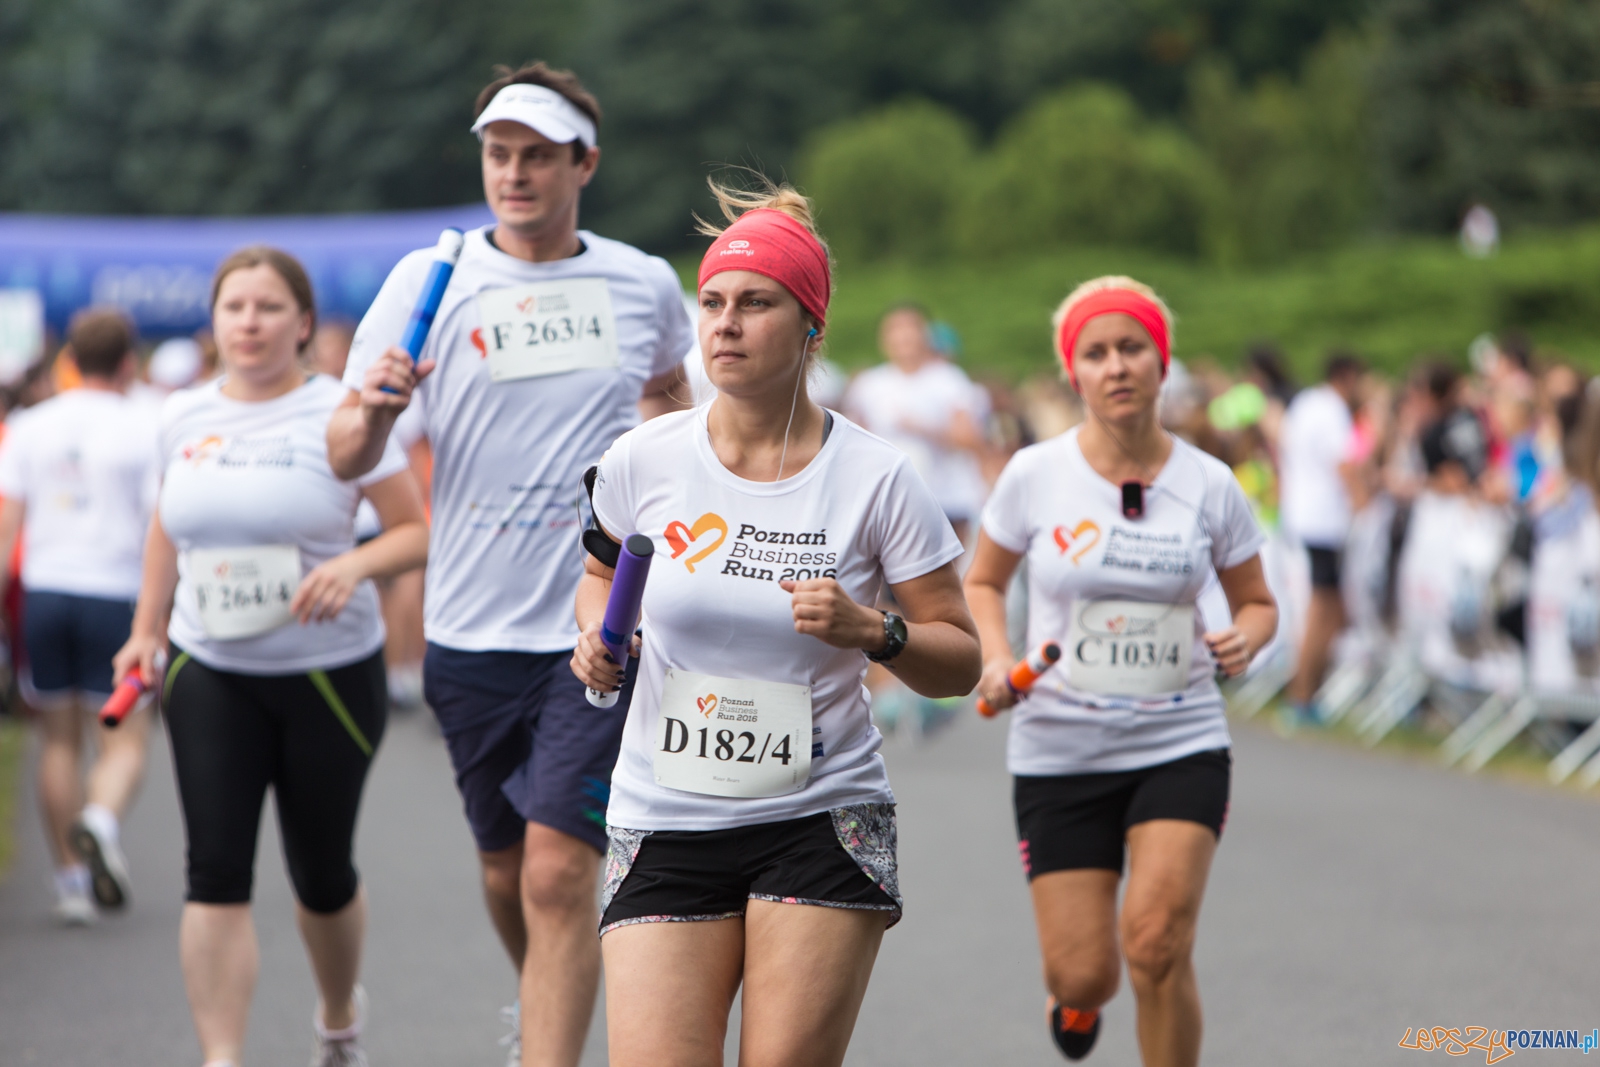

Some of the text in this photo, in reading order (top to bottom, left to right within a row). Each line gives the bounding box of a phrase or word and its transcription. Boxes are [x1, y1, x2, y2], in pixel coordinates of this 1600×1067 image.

[492, 315, 602, 350] F 263/4
[736, 523, 828, 546] Poznań
[728, 541, 838, 566] Business
[720, 559, 774, 582] Run
[1075, 636, 1180, 668] C 103/4
[718, 704, 759, 715] Business
[720, 696, 755, 707] Poznań
[716, 711, 759, 723] Run 2016
[660, 716, 690, 754] D
[695, 727, 792, 766] 182/4
